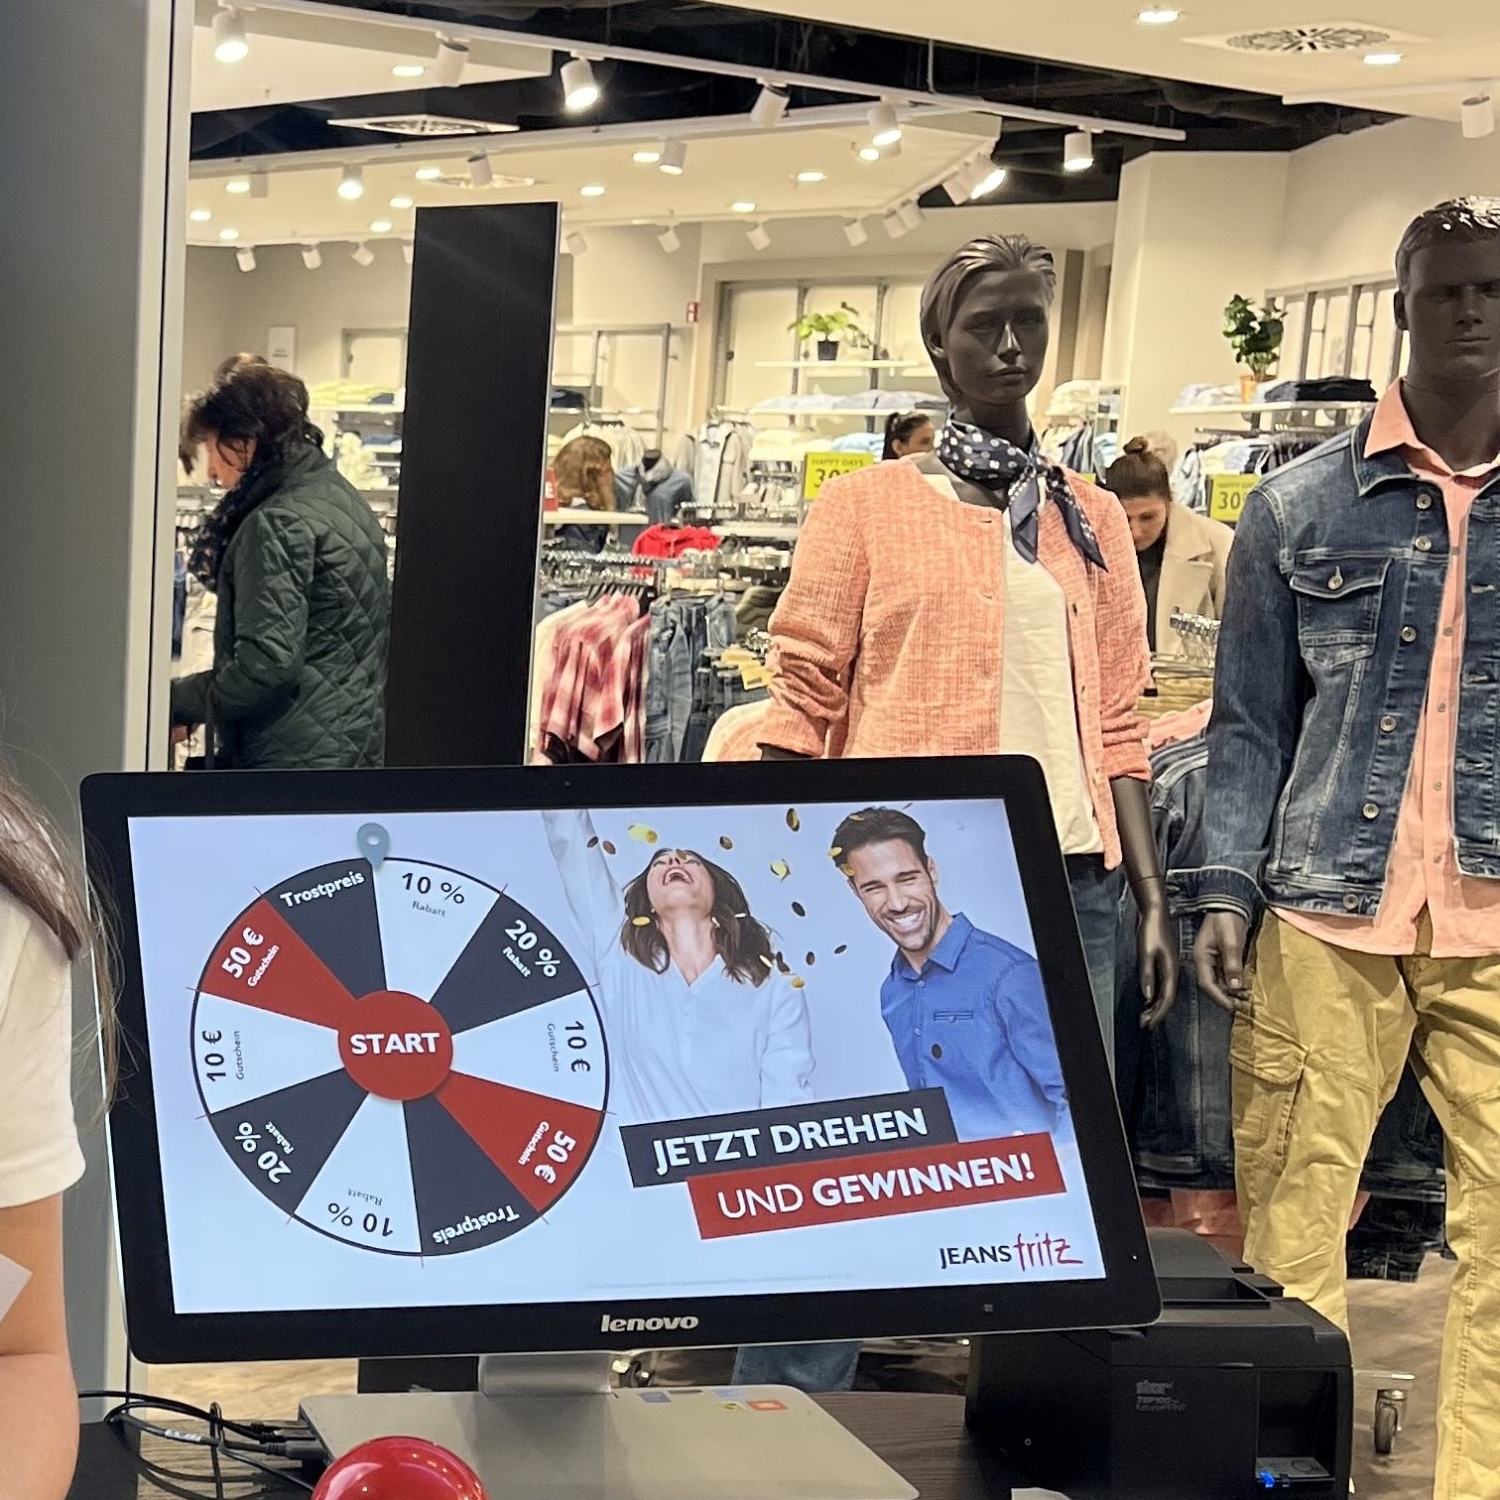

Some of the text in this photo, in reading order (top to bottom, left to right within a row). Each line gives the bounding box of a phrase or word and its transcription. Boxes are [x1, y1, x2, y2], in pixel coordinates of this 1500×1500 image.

[280, 871, 365, 907] Trostpreis
[401, 872, 465, 904] 10 %
[412, 900, 446, 917] Rabatt
[221, 927, 264, 979] 50 €
[247, 944, 280, 987] Gutschein
[502, 946, 532, 978] Rabatt
[505, 919, 561, 977] 20 %
[202, 1030, 226, 1082] 10 €
[233, 1030, 245, 1080] Gutschein
[349, 1033, 441, 1056] START
[547, 1022, 559, 1073] Gutschein
[565, 1020, 591, 1073] 10 €
[234, 1122, 292, 1184] 20 %
[265, 1121, 294, 1155] Rabatt
[518, 1121, 549, 1166] Gutschein
[534, 1130, 576, 1184] 50 €
[652, 1107, 928, 1176] JETZT DREHEN
[347, 1188, 383, 1207] Rabatt
[717, 1152, 1035, 1219] UND GEWINNEN!
[327, 1202, 393, 1237] 10 %
[432, 1204, 520, 1245] Trostpreis
[939, 1232, 1083, 1271] JEANS fritz
[600, 1312, 699, 1334] lenovo
